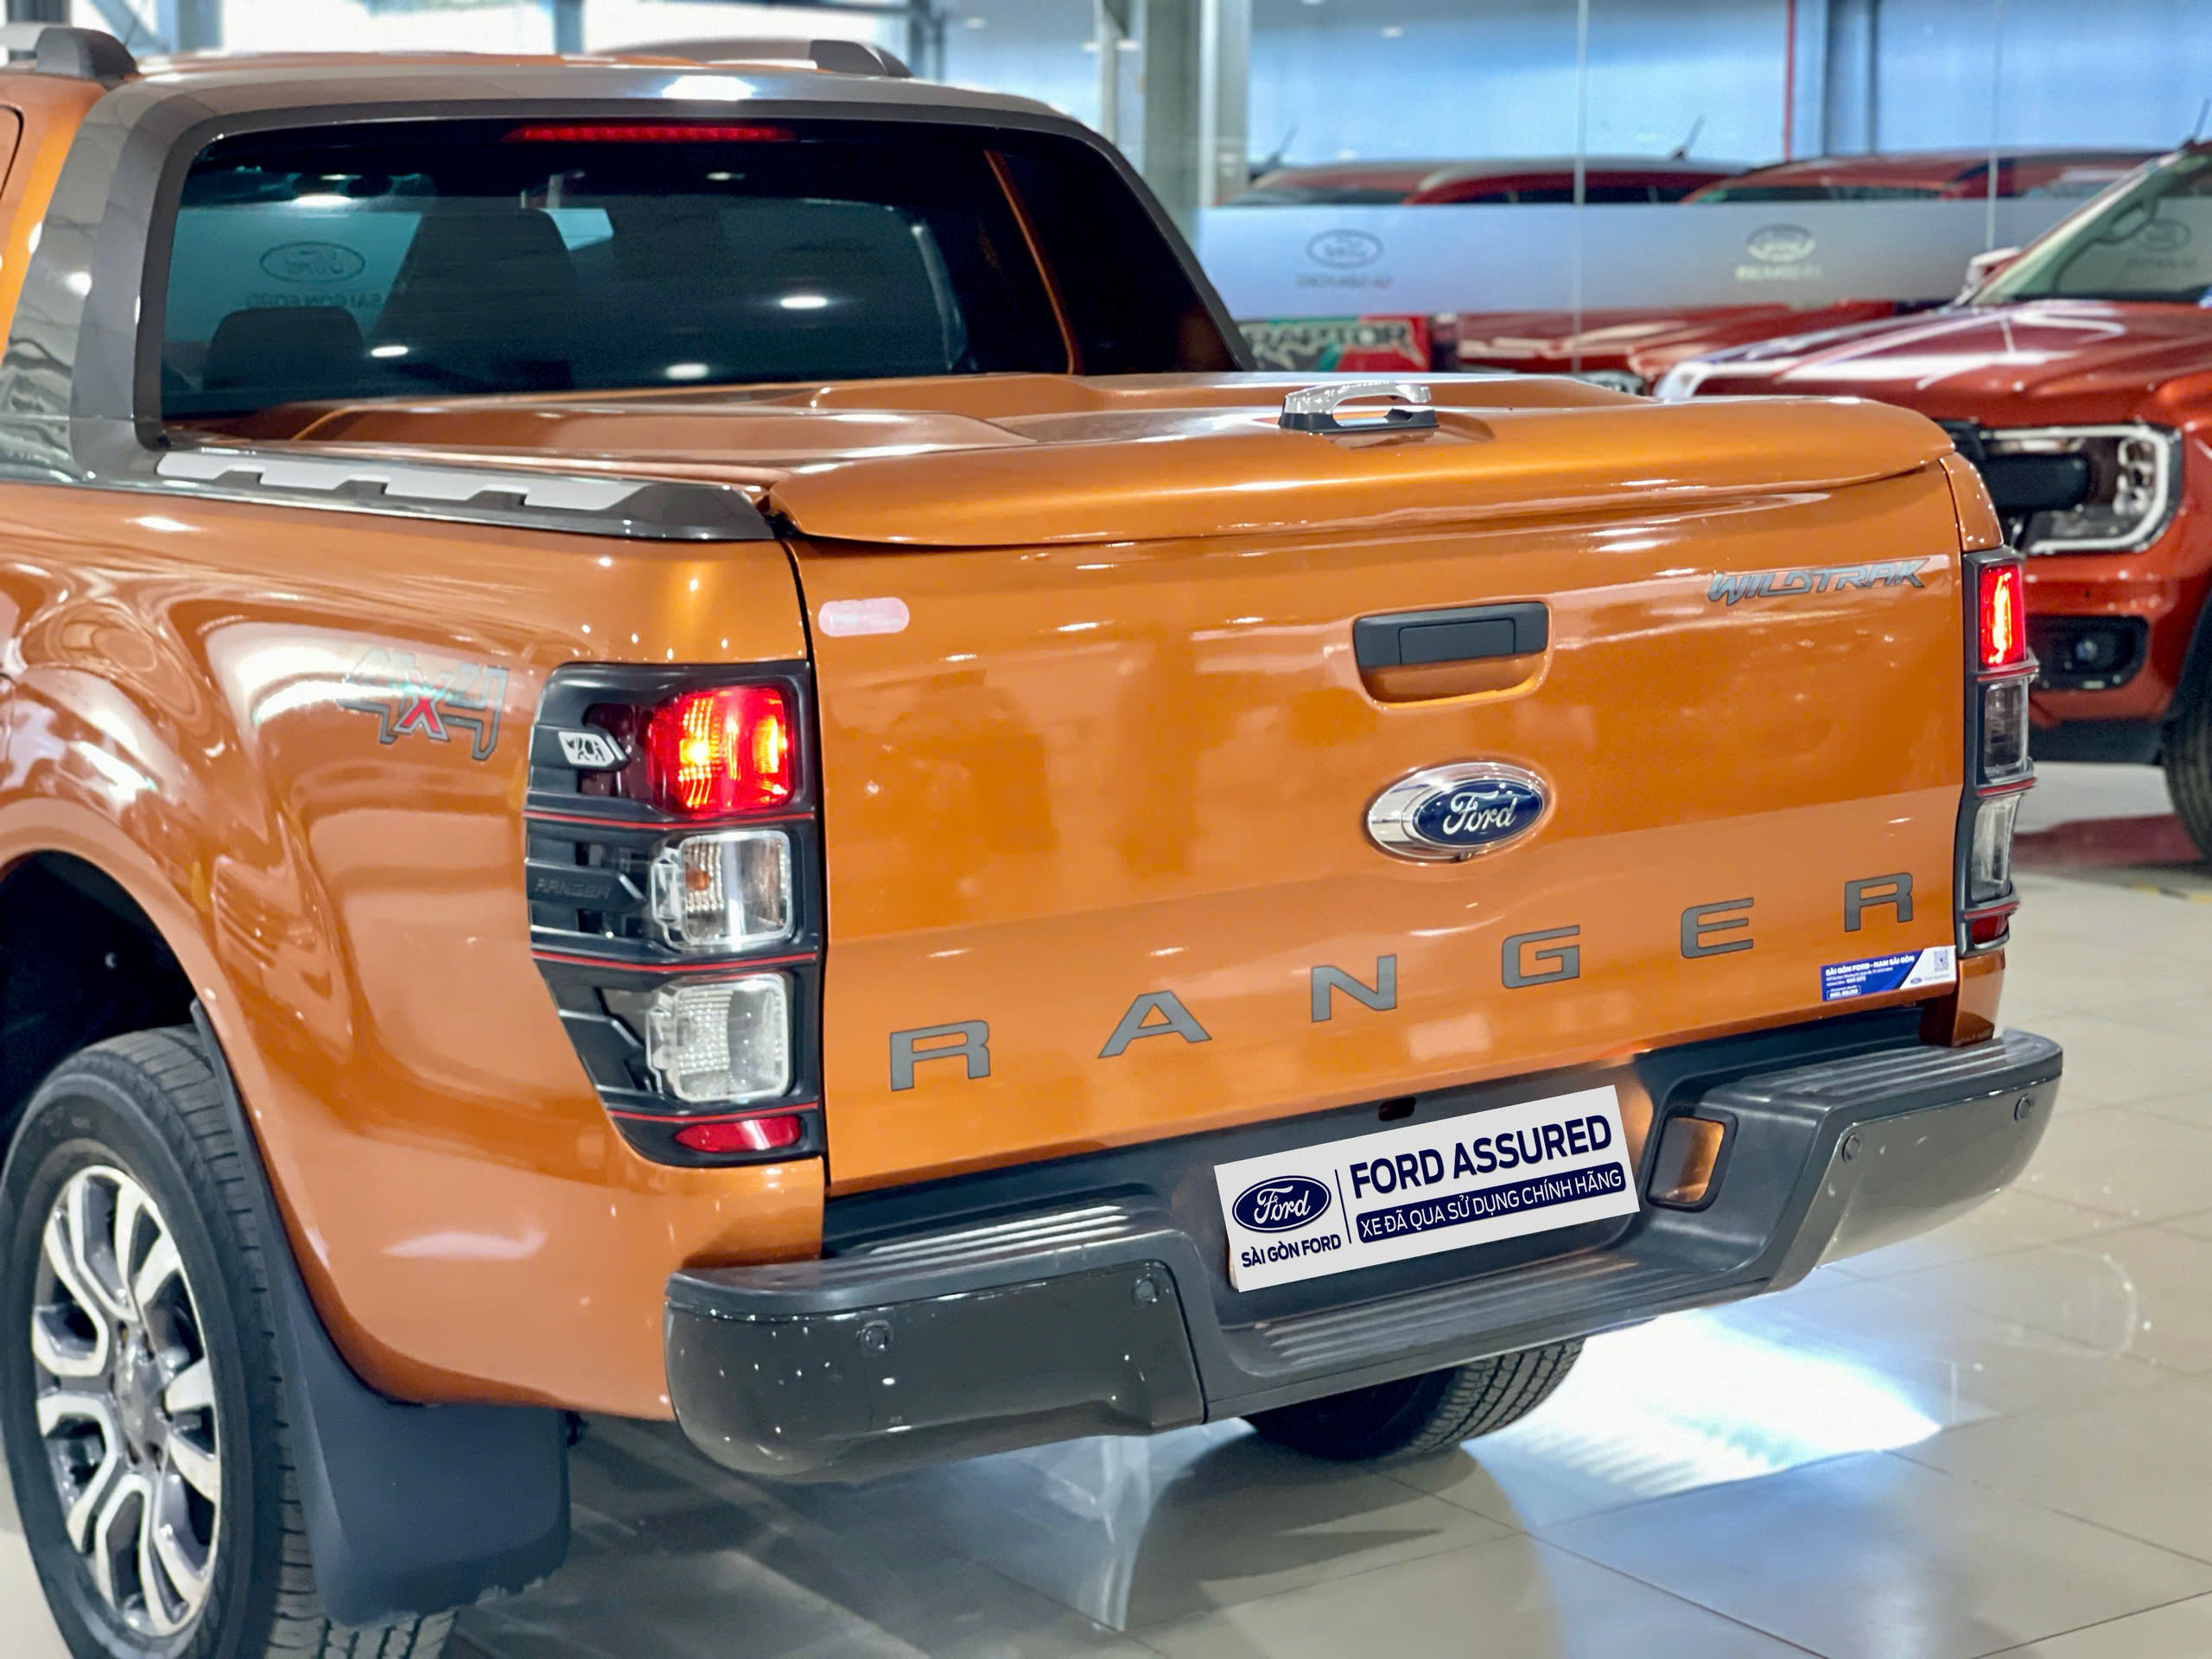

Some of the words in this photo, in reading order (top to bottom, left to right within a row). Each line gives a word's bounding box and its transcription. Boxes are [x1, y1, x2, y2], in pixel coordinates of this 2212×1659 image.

[1707, 557, 1930, 606] WILDTRAK
[1442, 790, 1518, 836] Ford
[889, 871, 1915, 1092] RANGER
[1853, 963, 1870, 972] FORD
[1874, 959, 1889, 968] NAM
